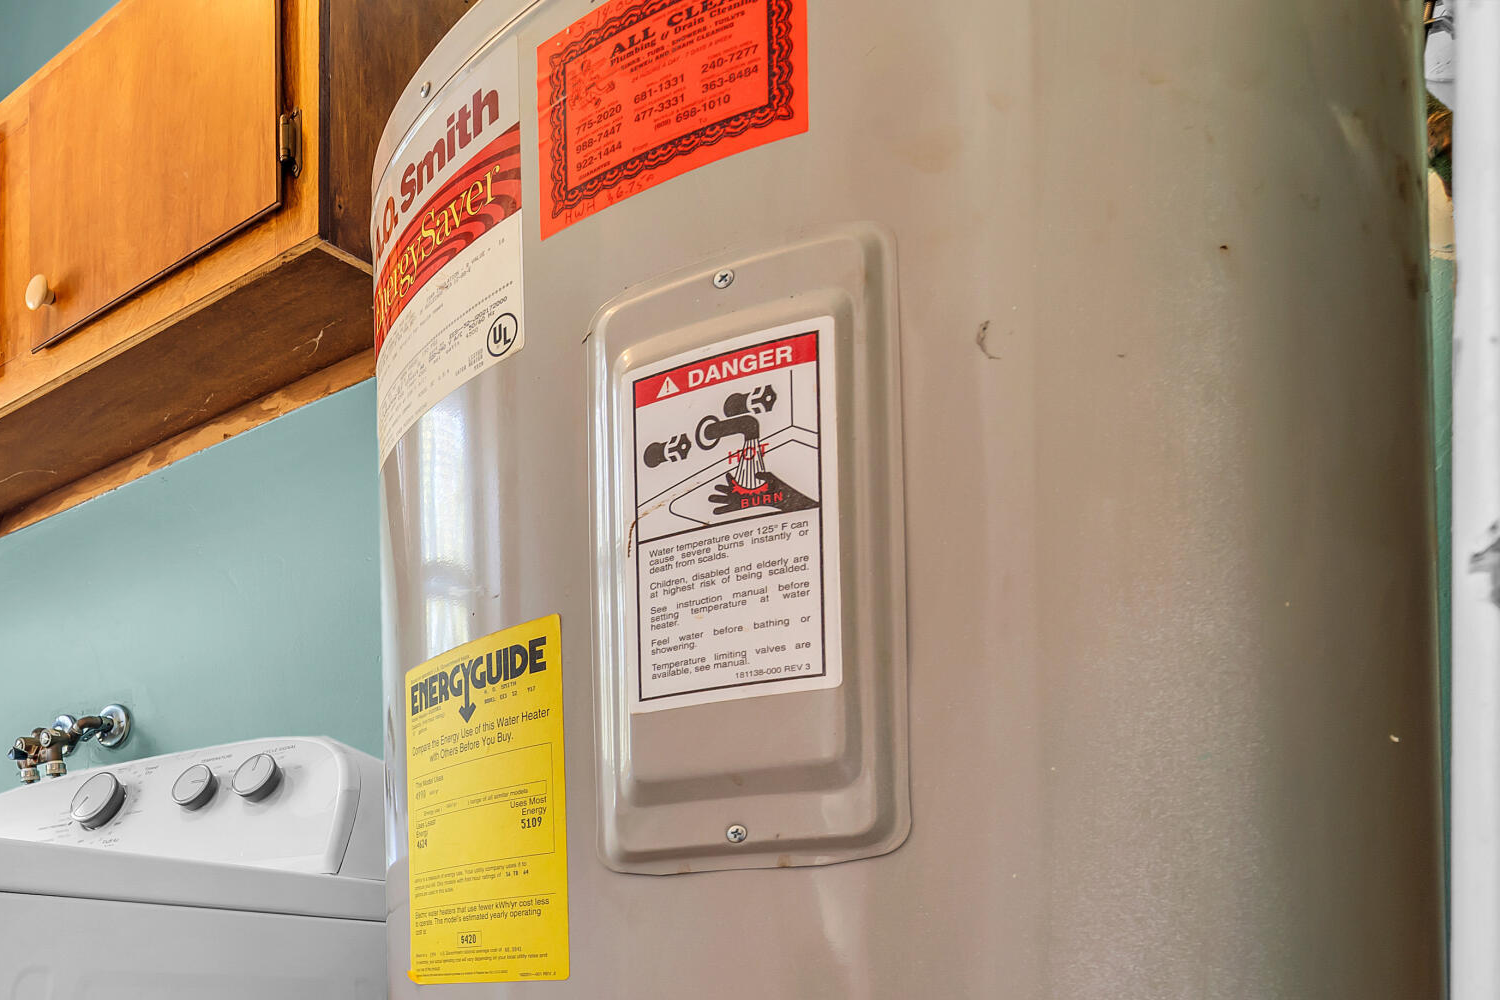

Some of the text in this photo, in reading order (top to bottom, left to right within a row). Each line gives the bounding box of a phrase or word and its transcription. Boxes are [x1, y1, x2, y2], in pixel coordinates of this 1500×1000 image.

[674, 17, 704, 34] Drain
[610, 27, 656, 58] ALL
[701, 44, 758, 73] 240-7277
[634, 74, 685, 105] 681-1331
[701, 65, 758, 93] 363-8484
[576, 104, 622, 136] 775-2020
[634, 94, 685, 123] 477-3331
[675, 94, 730, 123] 698-1010
[401, 88, 499, 213] Smith
[576, 123, 622, 154] 988-7447
[576, 141, 622, 172] 922-1444
[493, 324, 511, 345] UL
[688, 345, 793, 388] DANGER
[728, 443, 769, 465] HOT
[741, 492, 783, 508] BURN
[649, 547, 674, 558] Water
[677, 534, 730, 552] temperature
[733, 530, 753, 540] over
[791, 520, 808, 529] can
[650, 555, 674, 566] cause
[682, 547, 711, 559] severe
[718, 540, 744, 551] burns
[751, 532, 791, 544] instantly
[650, 552, 729, 574] death from scalds.
[650, 577, 687, 590] Children,
[692, 568, 730, 581] disabled
[735, 565, 751, 573] and
[757, 557, 788, 569] elderly
[663, 583, 694, 596] highest
[700, 580, 715, 588] risk
[722, 575, 730, 584] of
[736, 571, 762, 582] being
[769, 564, 809, 576] scalded.
[651, 581, 809, 614] See instruction manual before
[651, 612, 679, 623] setting
[691, 600, 746, 614] temperature
[783, 590, 810, 600] water
[651, 620, 679, 631] heater.
[652, 637, 669, 647] Feel
[679, 632, 703, 641] water
[714, 626, 743, 636] before
[754, 618, 790, 630] bathing
[652, 642, 697, 656] showering.
[652, 657, 706, 671] Temperature
[714, 650, 746, 660] limiting
[756, 644, 786, 654] valves
[411, 636, 546, 717] ENERGYGUIDE
[652, 668, 692, 680] available,
[714, 659, 750, 669] manual.
[736, 667, 781, 678] 181138-000
[461, 728, 473, 738] Use
[475, 726, 481, 734] of
[483, 722, 494, 731] this
[497, 716, 518, 728] Water
[522, 709, 550, 722] Heater
[460, 740, 479, 752] Before
[481, 736, 495, 746] You
[498, 732, 513, 744] Buy.
[510, 796, 547, 809] Uses Most
[522, 806, 546, 816] Energy
[521, 816, 542, 829] 5109
[463, 912, 488, 922] estimated
[490, 911, 508, 920] yearly
[510, 908, 541, 918] operating
[478, 904, 493, 912] fewer
[496, 900, 517, 909] kWh/yr
